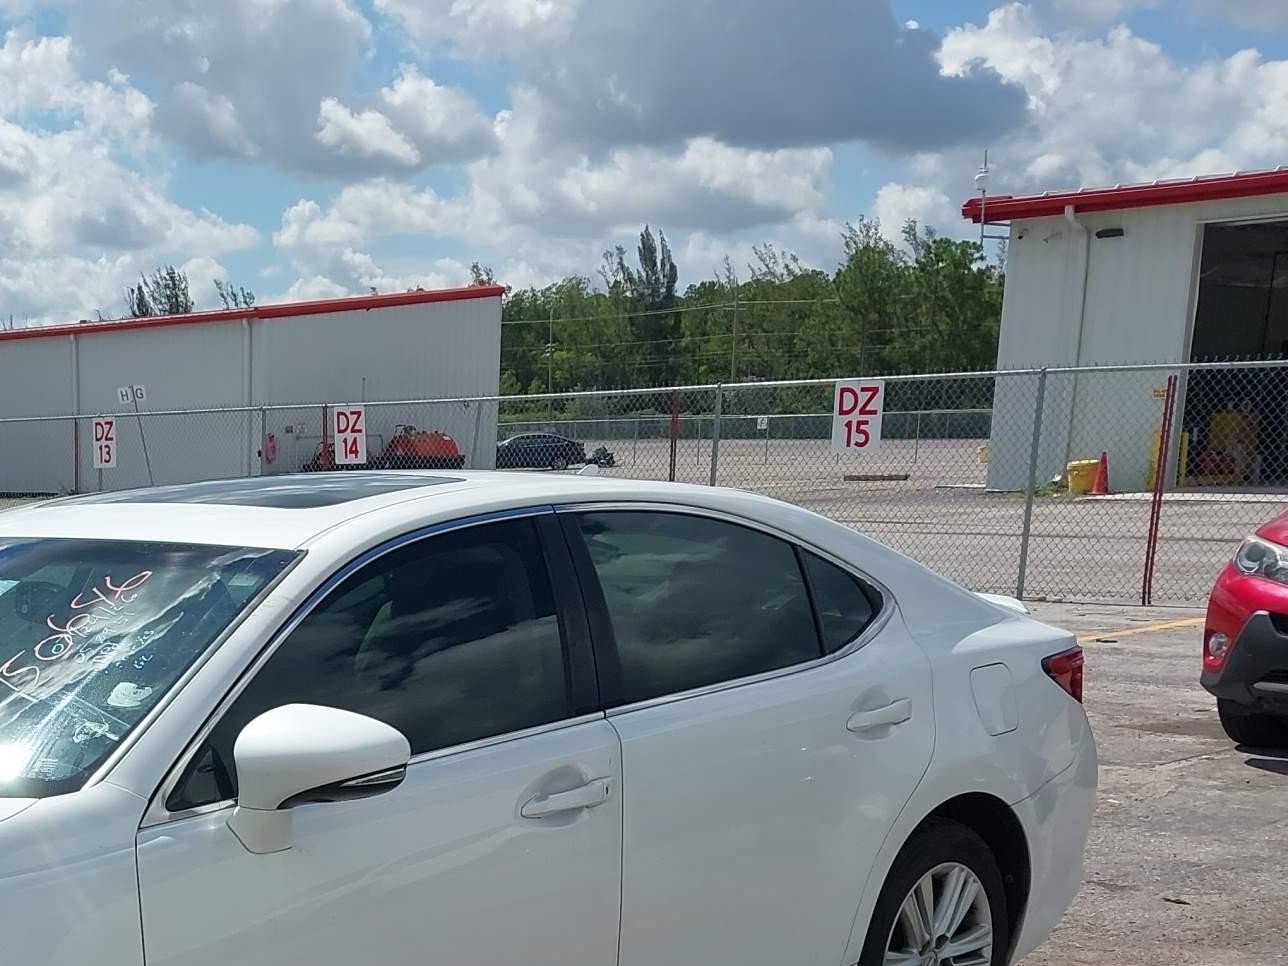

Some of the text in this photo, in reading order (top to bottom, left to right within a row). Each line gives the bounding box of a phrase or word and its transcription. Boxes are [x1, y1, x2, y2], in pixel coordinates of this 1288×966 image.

[120, 388, 144, 402] H G
[838, 386, 880, 416] DZ
[95, 420, 114, 442] DZ
[336, 410, 363, 434] DZ
[844, 419, 870, 448] 15
[99, 444, 111, 465] 13
[343, 436, 360, 459] 14
